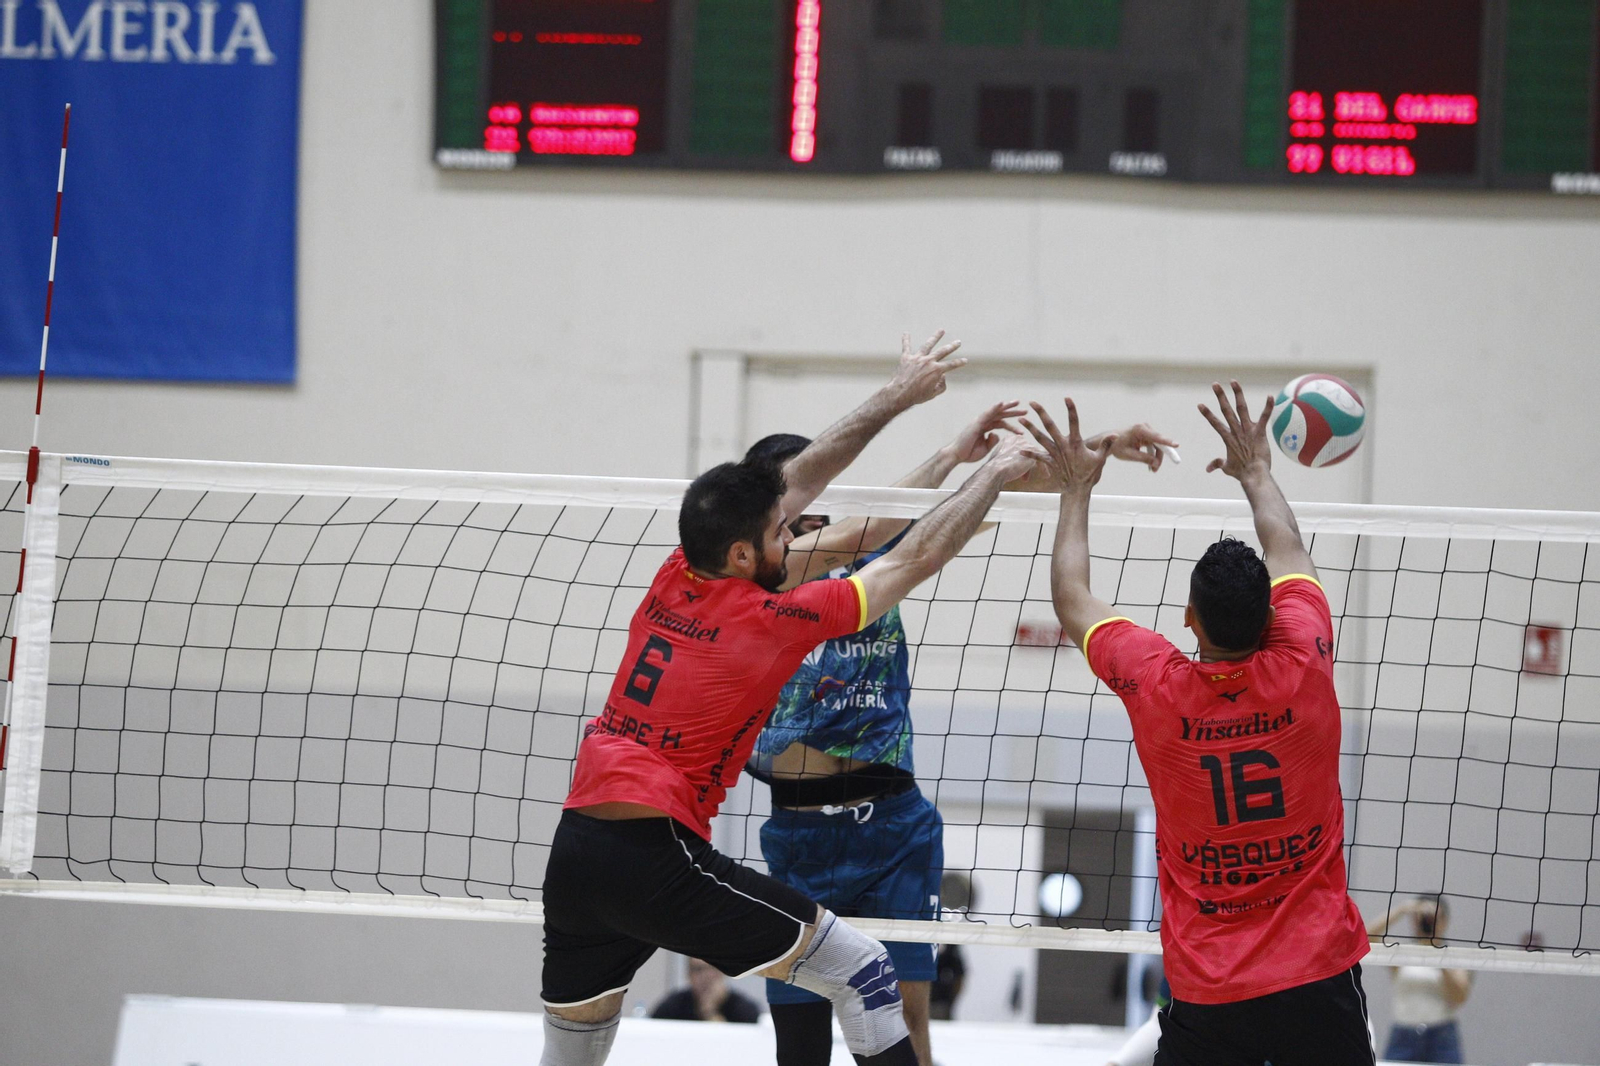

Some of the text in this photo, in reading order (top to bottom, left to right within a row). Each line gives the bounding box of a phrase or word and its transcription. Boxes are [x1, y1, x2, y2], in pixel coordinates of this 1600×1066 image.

[72, 456, 111, 467] MONDO
[645, 595, 720, 642] Ynsadiet
[623, 633, 673, 707] 6
[1179, 707, 1295, 742] Ynsadiet
[1200, 748, 1286, 827] 16
[1181, 824, 1323, 870] VÁSQUEZ
